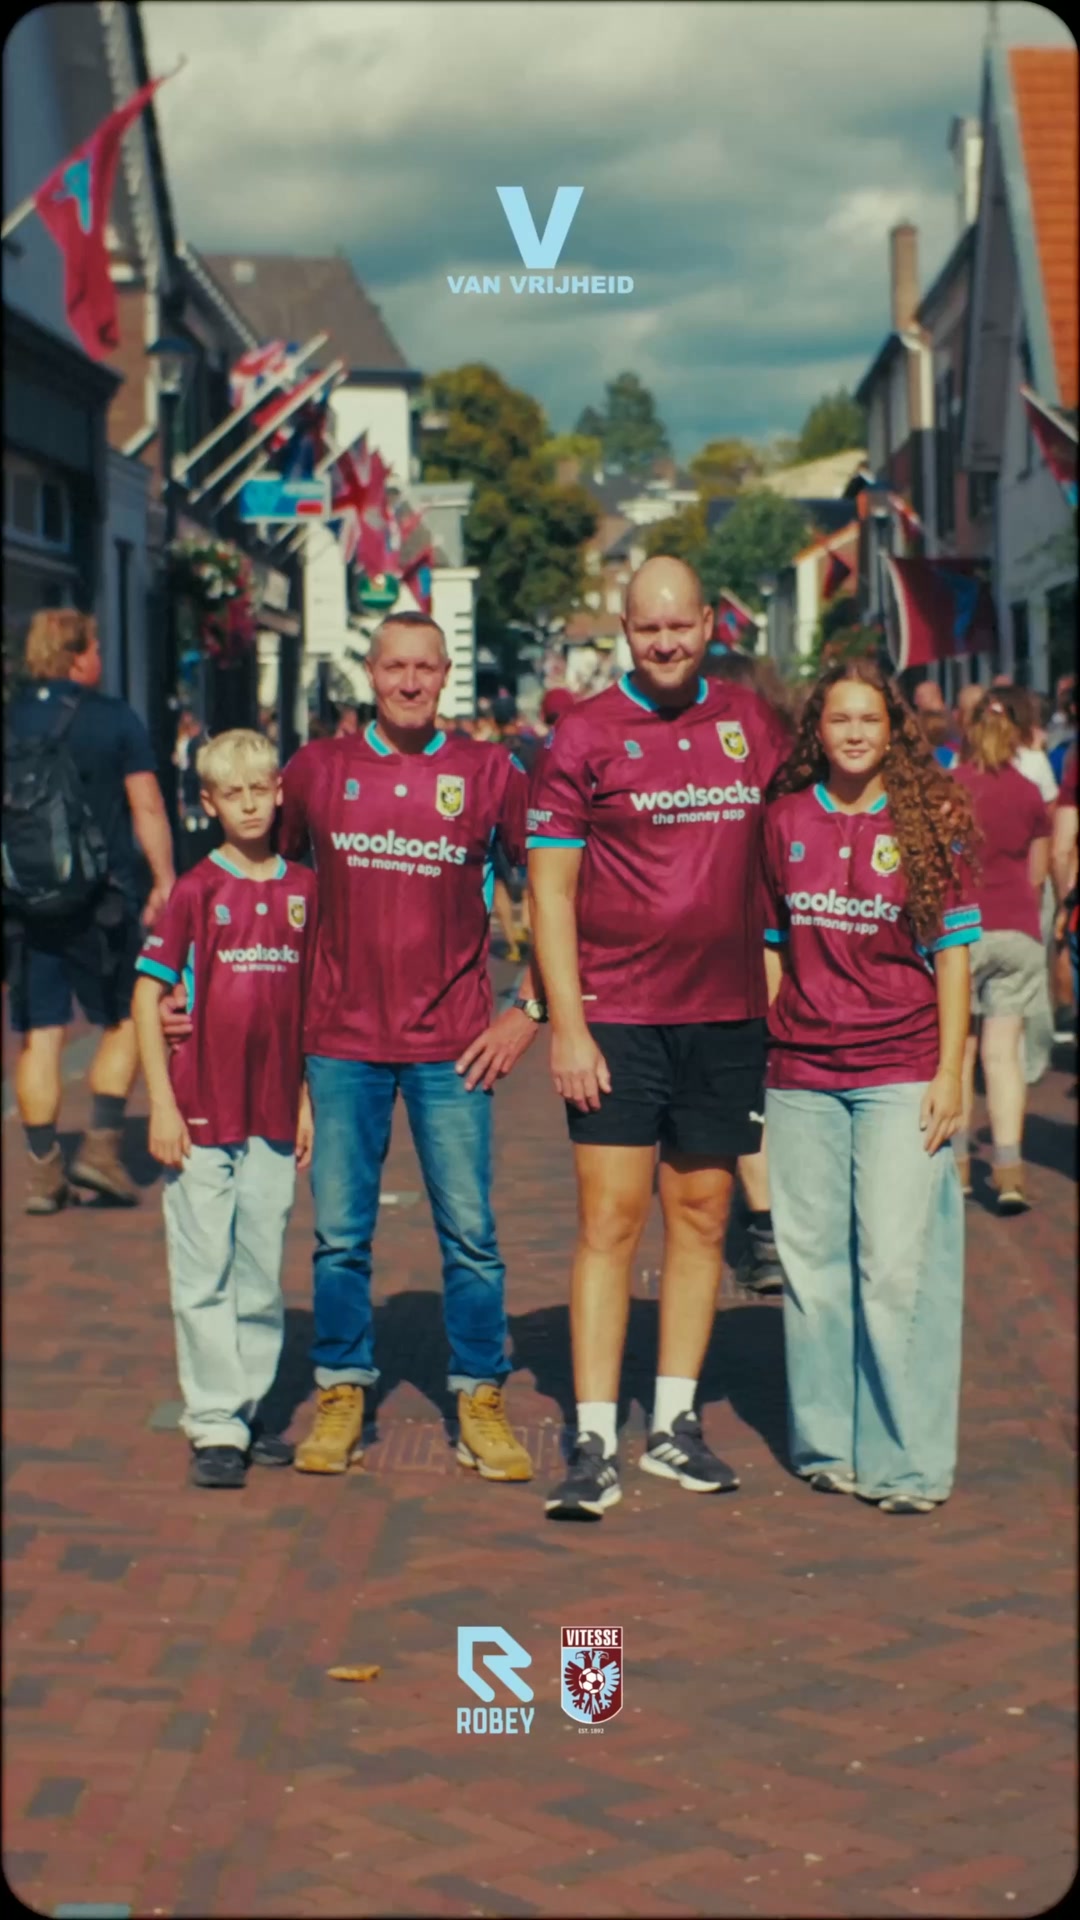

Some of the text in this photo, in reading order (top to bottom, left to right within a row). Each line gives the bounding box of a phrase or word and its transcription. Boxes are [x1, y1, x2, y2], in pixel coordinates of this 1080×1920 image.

[630, 779, 761, 812] woolsocks
[652, 808, 745, 825] the money app
[331, 829, 467, 865] woolsocks
[347, 855, 442, 878] the money app
[790, 913, 813, 926] the
[813, 916, 855, 935] money
